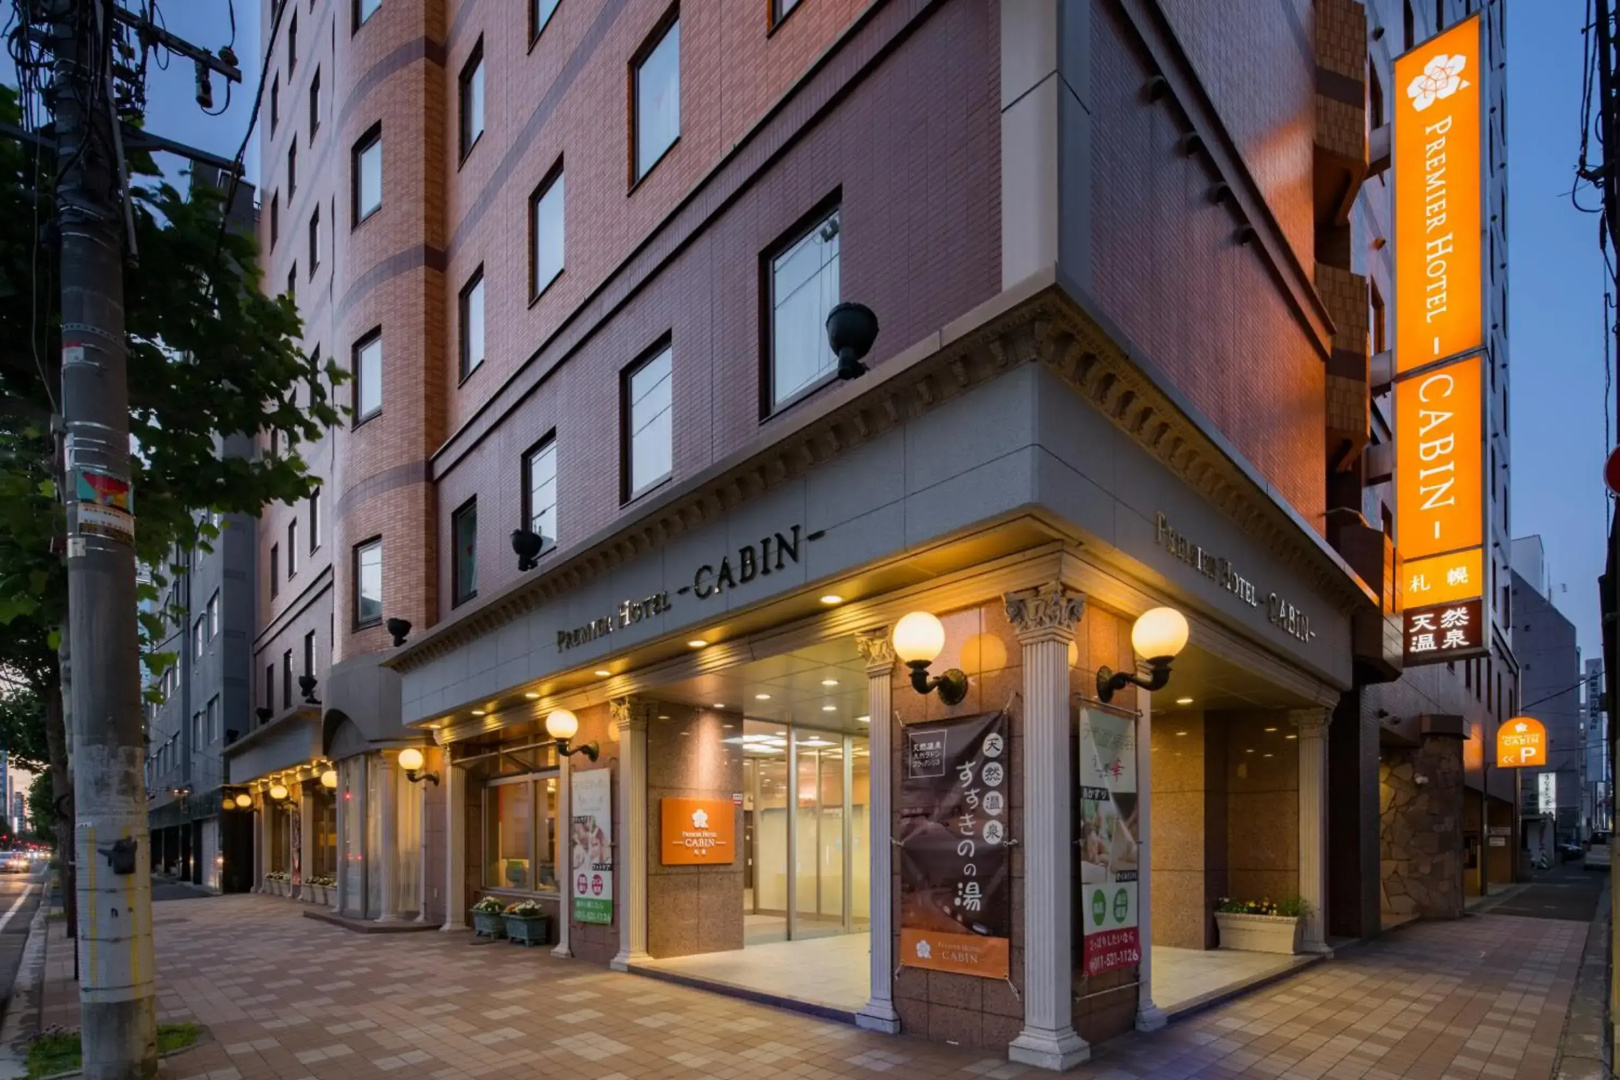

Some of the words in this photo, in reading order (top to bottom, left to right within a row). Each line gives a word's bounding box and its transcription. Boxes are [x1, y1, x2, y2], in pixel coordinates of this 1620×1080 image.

[1425, 115, 1453, 233] PREMIER
[1426, 232, 1453, 323] HOTEL
[1219, 557, 1258, 608] HOTEL
[1409, 566, 1469, 592] 札幌
[556, 616, 613, 653] PREMIER
[618, 591, 672, 629] HOTEL
[1409, 607, 1470, 633] 天然
[1409, 629, 1470, 653] 温泉
[1503, 737, 1539, 746] CABIN
[1521, 747, 1537, 763] P
[984, 736, 1002, 840] 天然温泉
[955, 761, 982, 912] すすきのの湯
